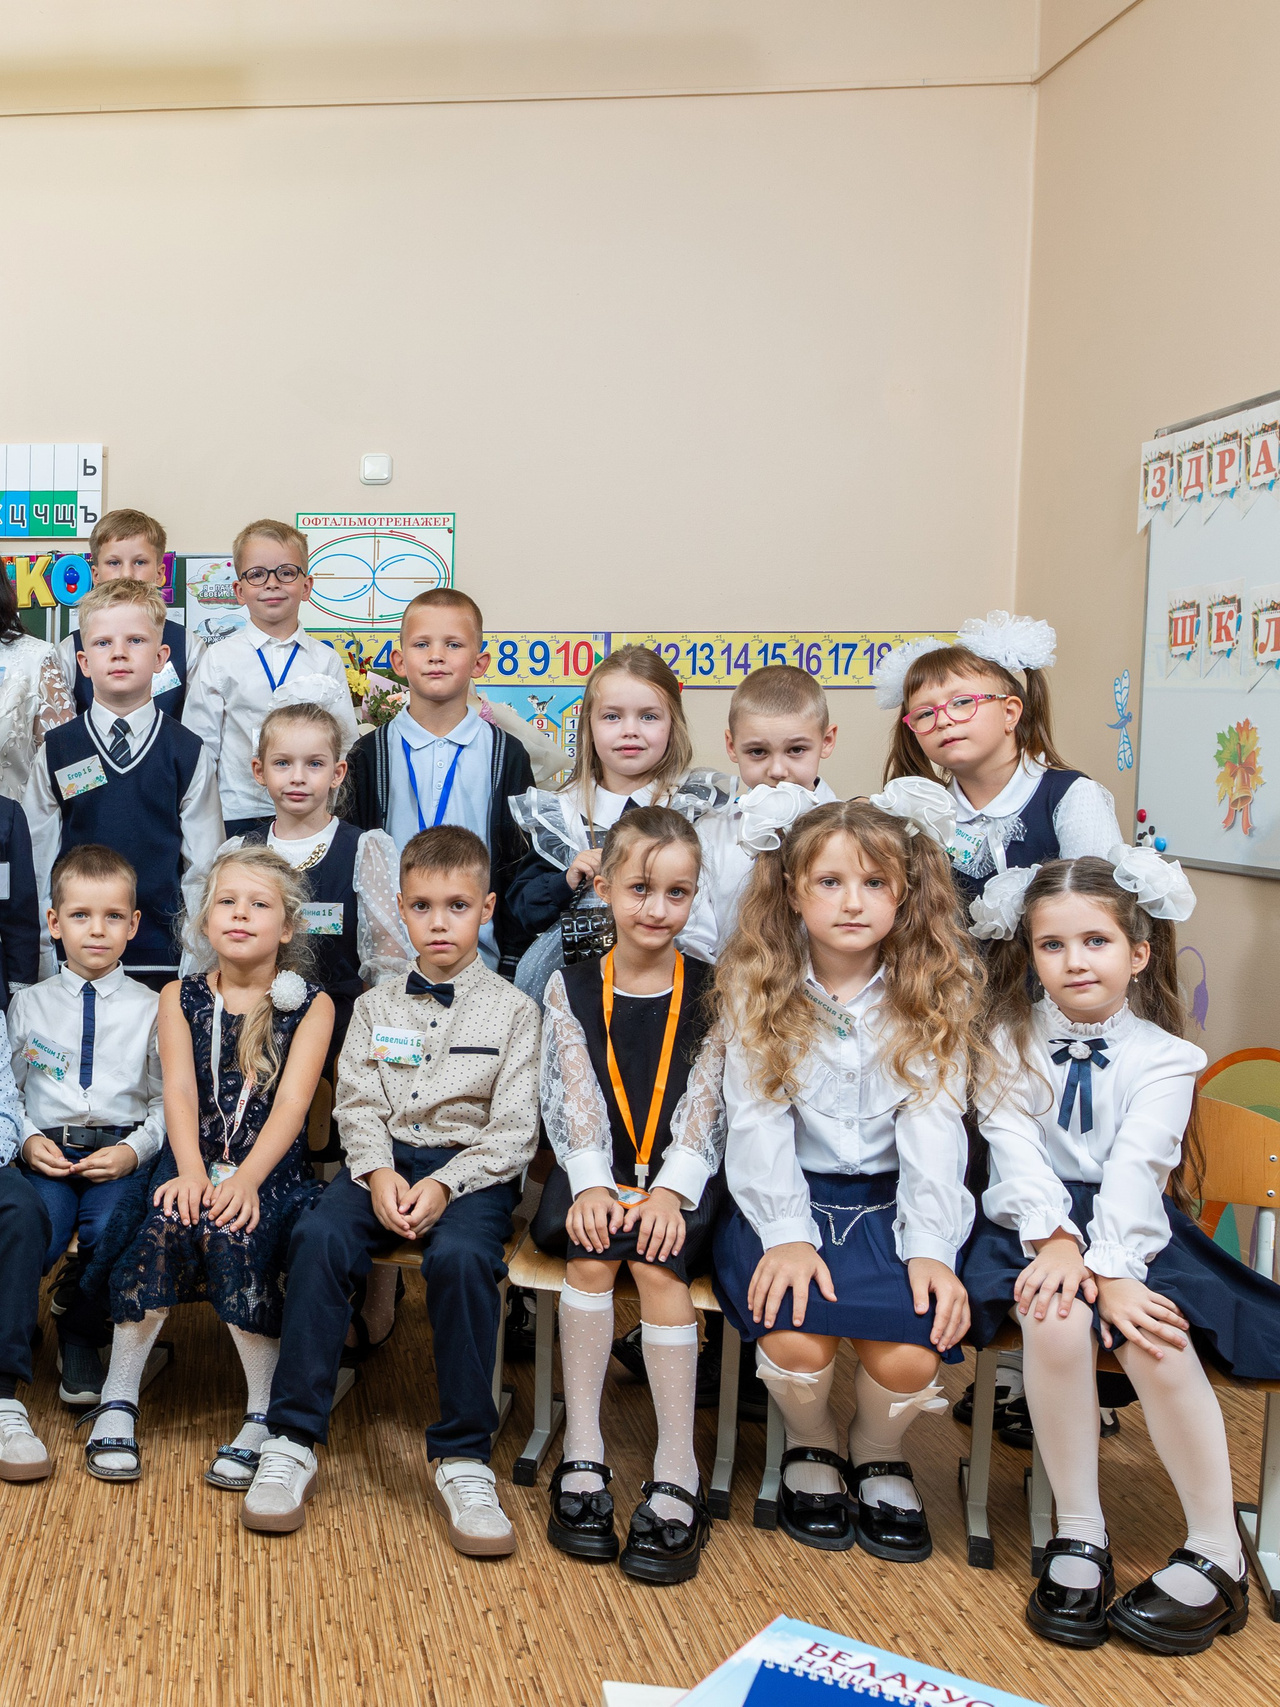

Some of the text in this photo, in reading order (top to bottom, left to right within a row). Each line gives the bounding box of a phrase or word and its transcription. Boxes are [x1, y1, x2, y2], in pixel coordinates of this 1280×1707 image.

[302, 515, 451, 527] ОФТАЛЬМОТРЕНАЖЕР
[497, 640, 519, 676] 8
[528, 640, 550, 676] 9
[555, 640, 594, 676] 10
[686, 643, 715, 675] 13
[721, 643, 751, 675] 14
[792, 643, 822, 676] 16
[828, 643, 858, 675] 17
[536, 719, 544, 729] 9
[569, 719, 575, 728] 1
[568, 733, 576, 743] 2
[568, 747, 575, 757] 3
[67, 771, 82, 780] Егор
[375, 1033, 408, 1045] Савелий
[32, 1038, 56, 1056] Максим
